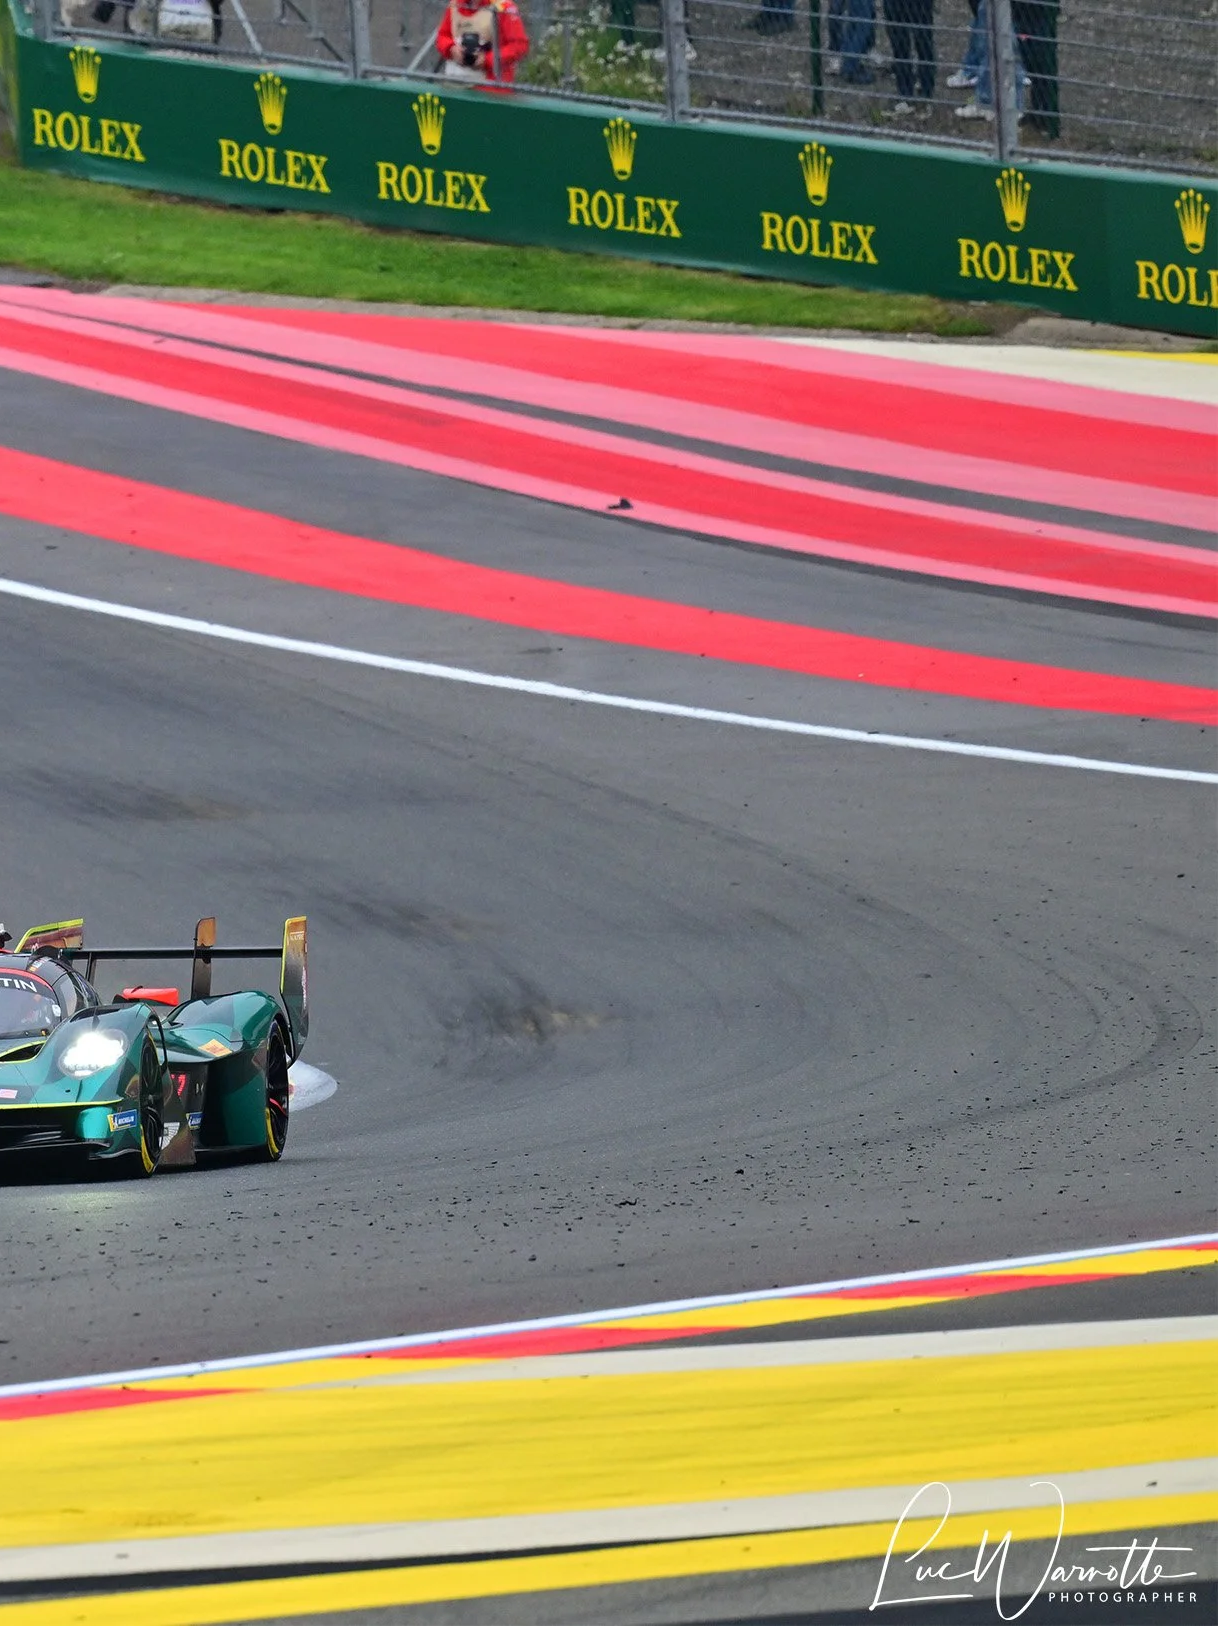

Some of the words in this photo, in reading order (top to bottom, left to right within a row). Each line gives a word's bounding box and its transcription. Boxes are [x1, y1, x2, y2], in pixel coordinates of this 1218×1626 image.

[33, 108, 146, 162] ROLEX
[219, 138, 331, 193] ROLEX
[377, 161, 491, 213] ROLEX
[567, 187, 682, 238] ROLEX
[761, 211, 878, 265] ROLEX
[958, 238, 1078, 292] ROLEX
